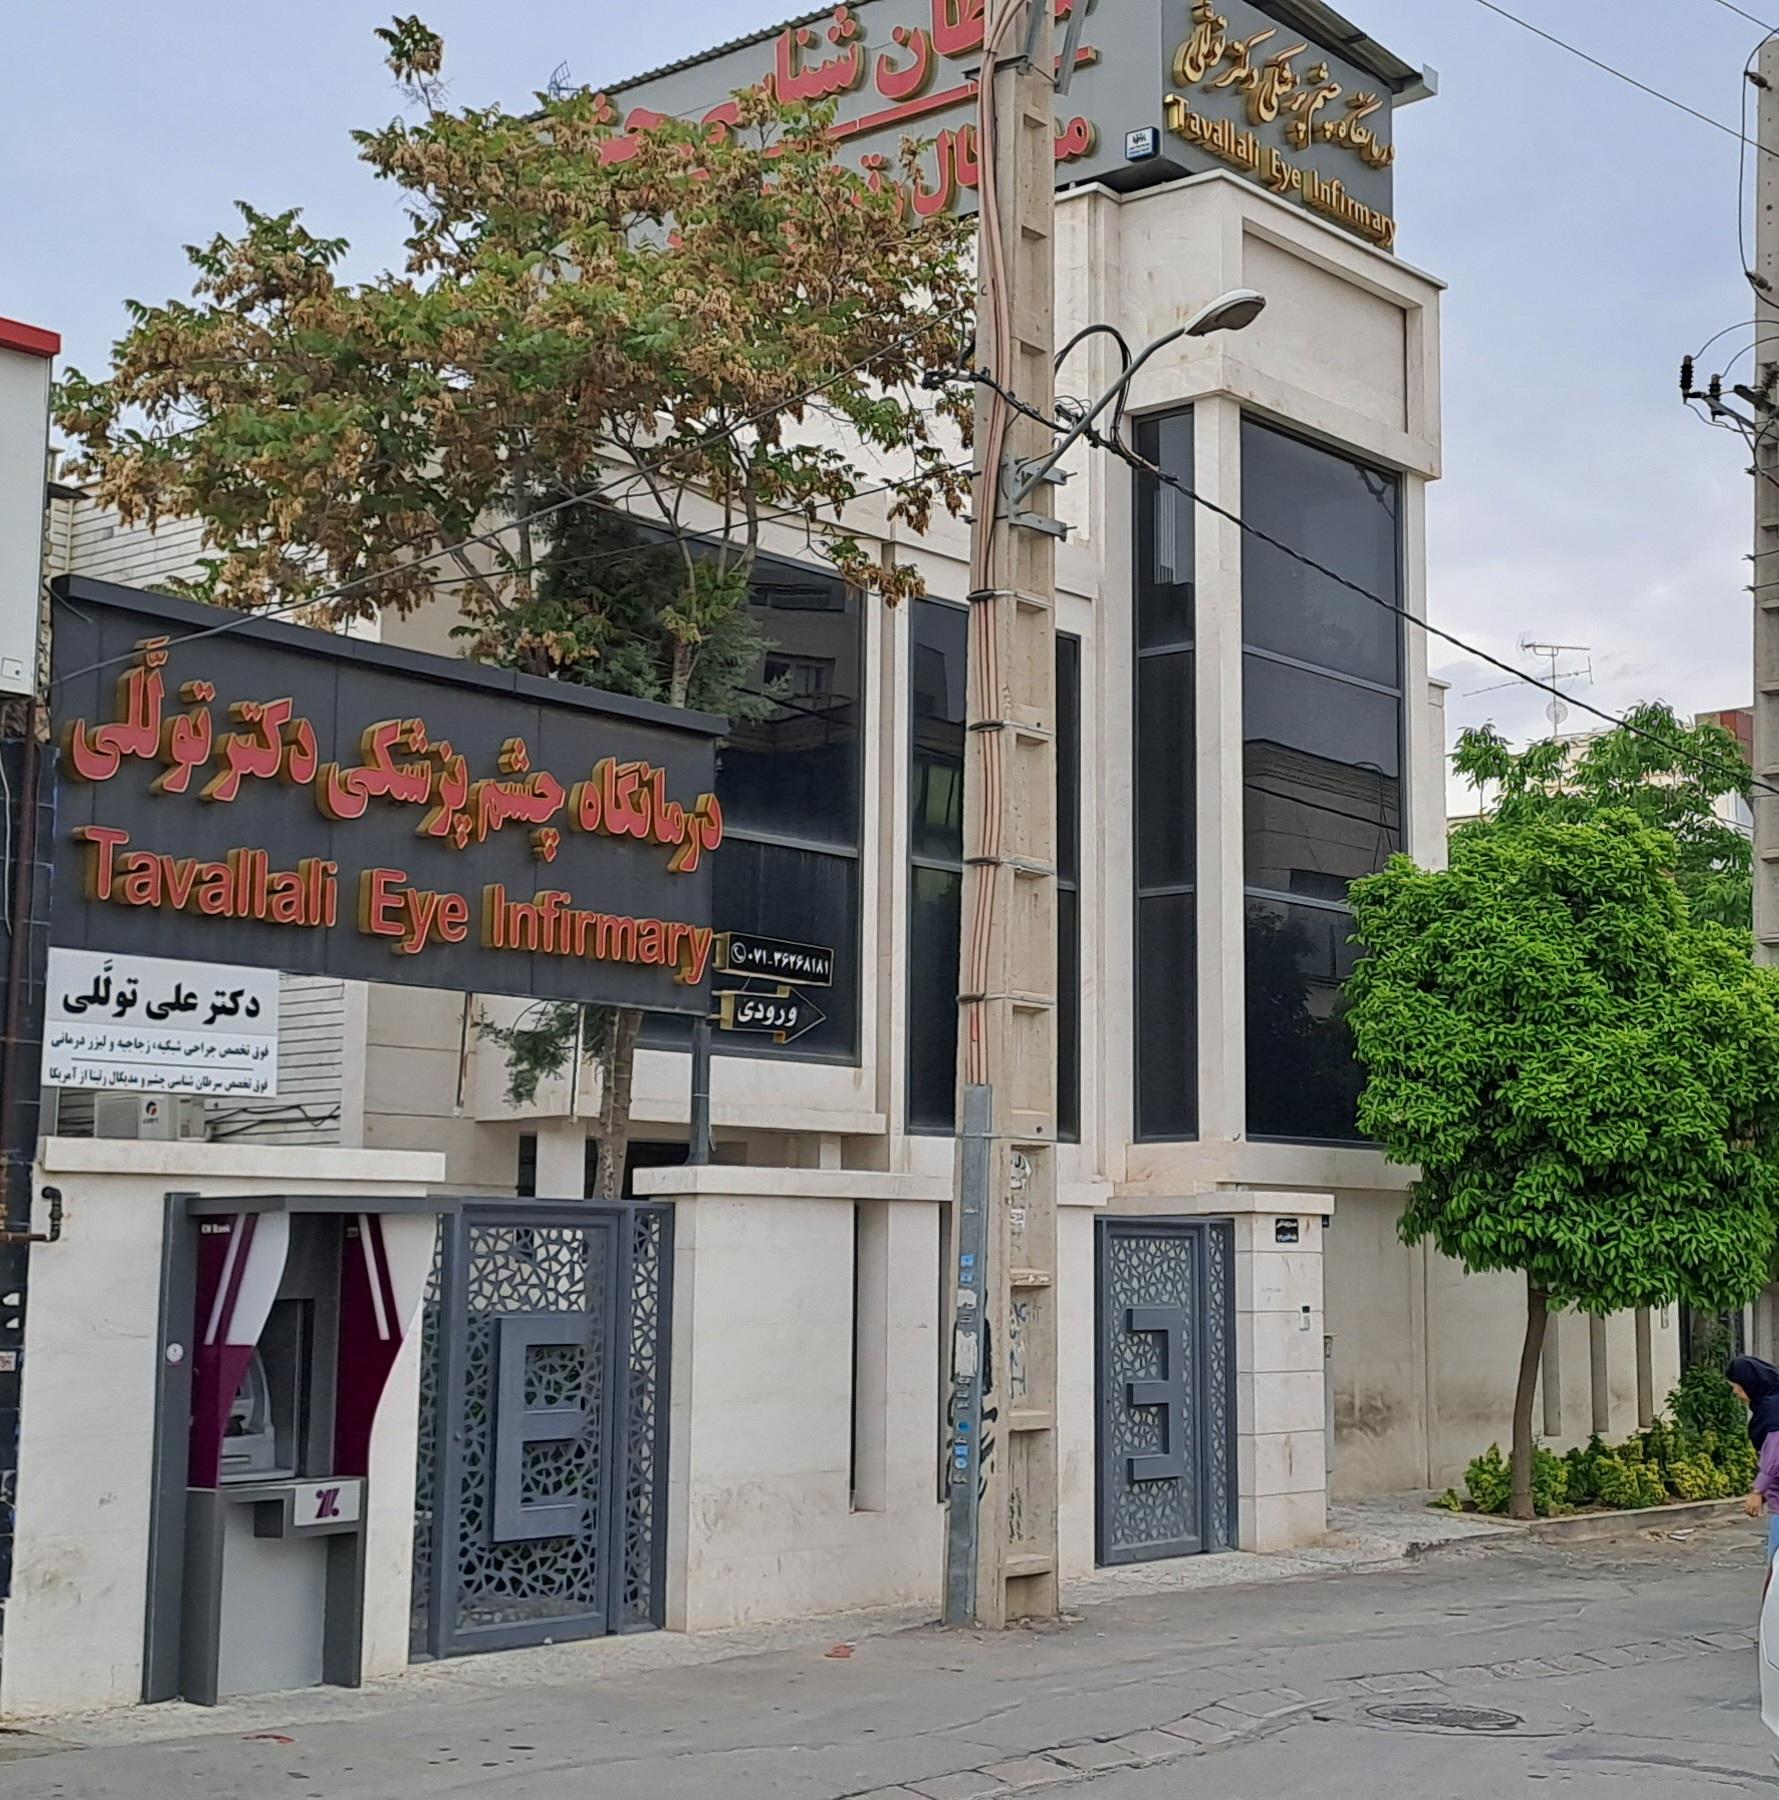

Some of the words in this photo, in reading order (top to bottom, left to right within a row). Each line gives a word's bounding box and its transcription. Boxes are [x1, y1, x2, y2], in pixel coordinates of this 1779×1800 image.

[1209, 27, 1277, 91] دکتر
[1164, 93, 1260, 172] Tavallali
[1259, 147, 1304, 194] Eye
[1304, 168, 1396, 248] Infirmary
[200, 697, 319, 802] دکتر
[316, 717, 473, 851] پزشکی
[569, 756, 723, 872] درمانگاه
[72, 825, 339, 928] Tavallali
[358, 867, 469, 954] Eye
[481, 883, 714, 985] Infirmary
[146, 982, 198, 1020] علی
[202, 988, 261, 1025] دکتر
[737, 1000, 798, 1027] ورودی
[51, 1031, 86, 1050] درمانی
[87, 1034, 107, 1051] لیزر
[108, 1041, 115, 1052] و
[117, 1037, 151, 1054] زجاجیه
[184, 1041, 217, 1059] جراحی
[218, 1044, 250, 1059] تخصص
[251, 1043, 269, 1061] فوق
[49, 1066, 78, 1083] آمریکا
[79, 1069, 88, 1085] از
[89, 1069, 107, 1086] رتینا
[108, 1071, 139, 1086] مدیکال
[140, 1077, 146, 1088] و
[147, 1072, 166, 1090] چشم
[167, 1074, 194, 1089] شناسی
[194, 1075, 223, 1092] سرطان
[224, 1078, 252, 1092] تخصص
[252, 1078, 269, 1094] فوق
